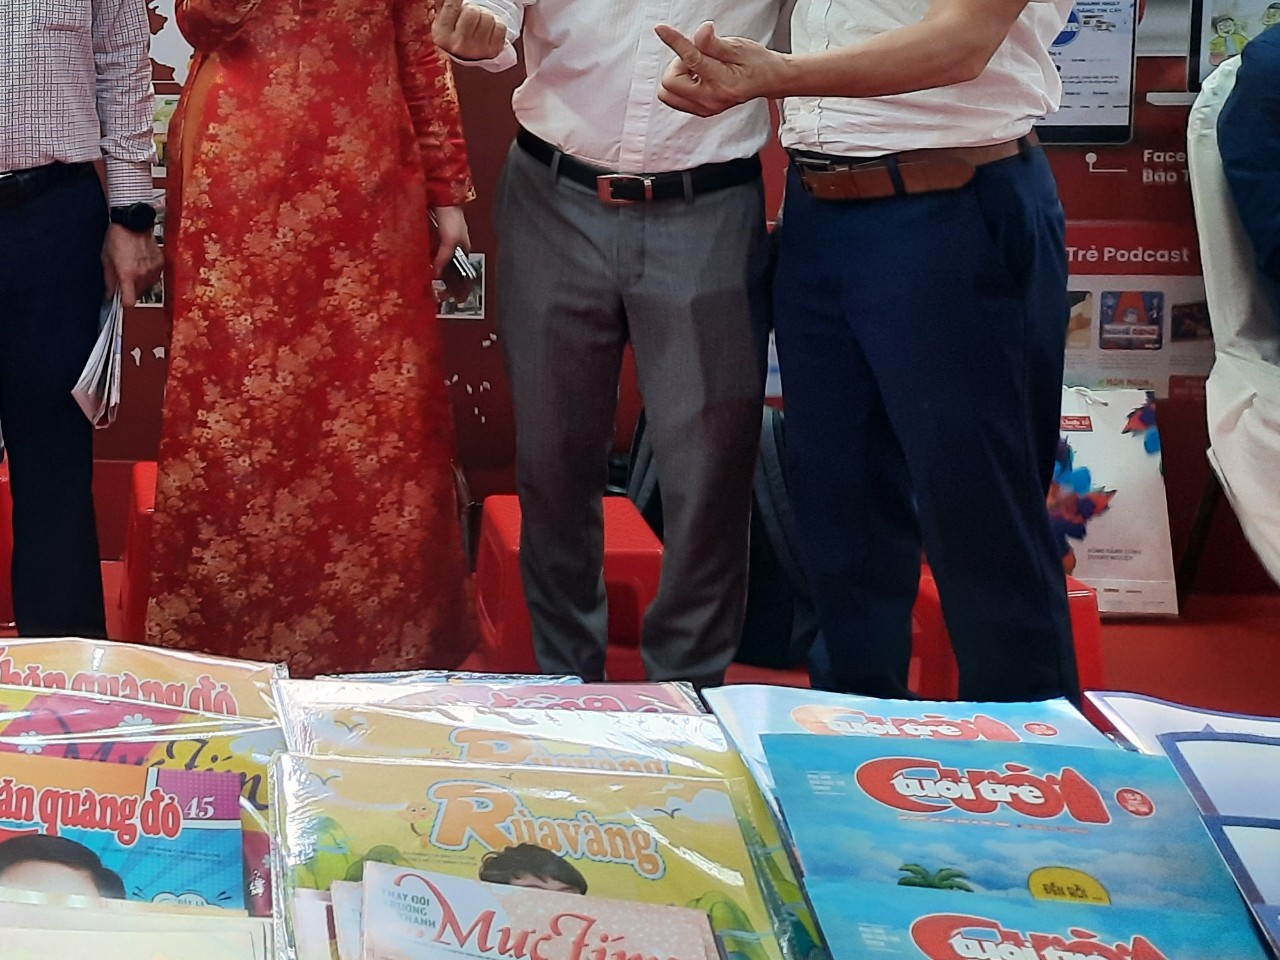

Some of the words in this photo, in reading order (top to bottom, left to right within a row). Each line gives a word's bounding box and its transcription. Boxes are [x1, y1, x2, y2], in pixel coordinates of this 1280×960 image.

[1143, 148, 1187, 163] Face
[1065, 245, 1099, 262] Trẻ
[1103, 246, 1191, 262] Podcast
[855, 755, 1112, 826] Cười
[38, 787, 139, 847] quàng
[139, 785, 185, 840] đỏ
[184, 794, 216, 818] 45
